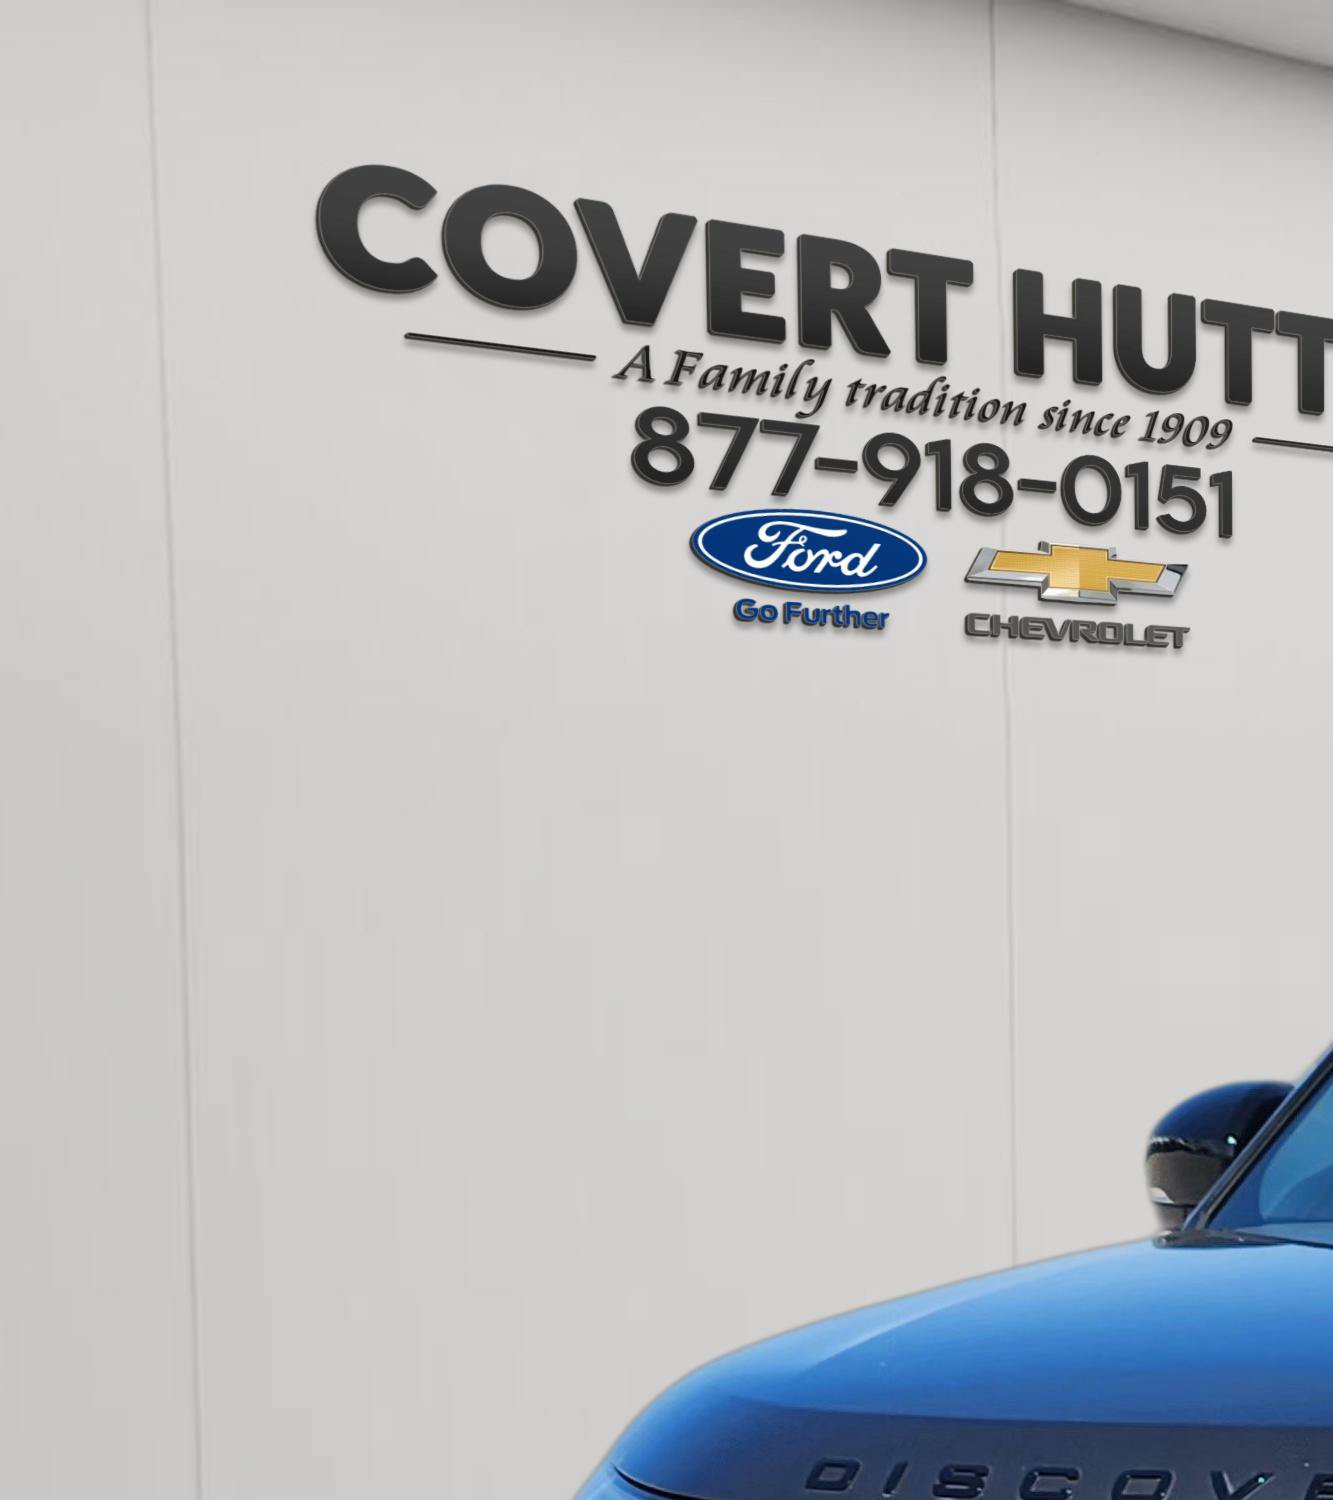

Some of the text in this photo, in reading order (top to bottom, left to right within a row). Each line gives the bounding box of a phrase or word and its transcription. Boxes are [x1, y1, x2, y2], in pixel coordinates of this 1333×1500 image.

[315, 164, 975, 367] COVERT
[612, 345, 1234, 450] A Family tradition since 1909
[630, 406, 1233, 540] 877-918-0151
[743, 520, 882, 579] Ford
[732, 598, 890, 631] Go Further
[964, 612, 1191, 649] CHEVROLET
